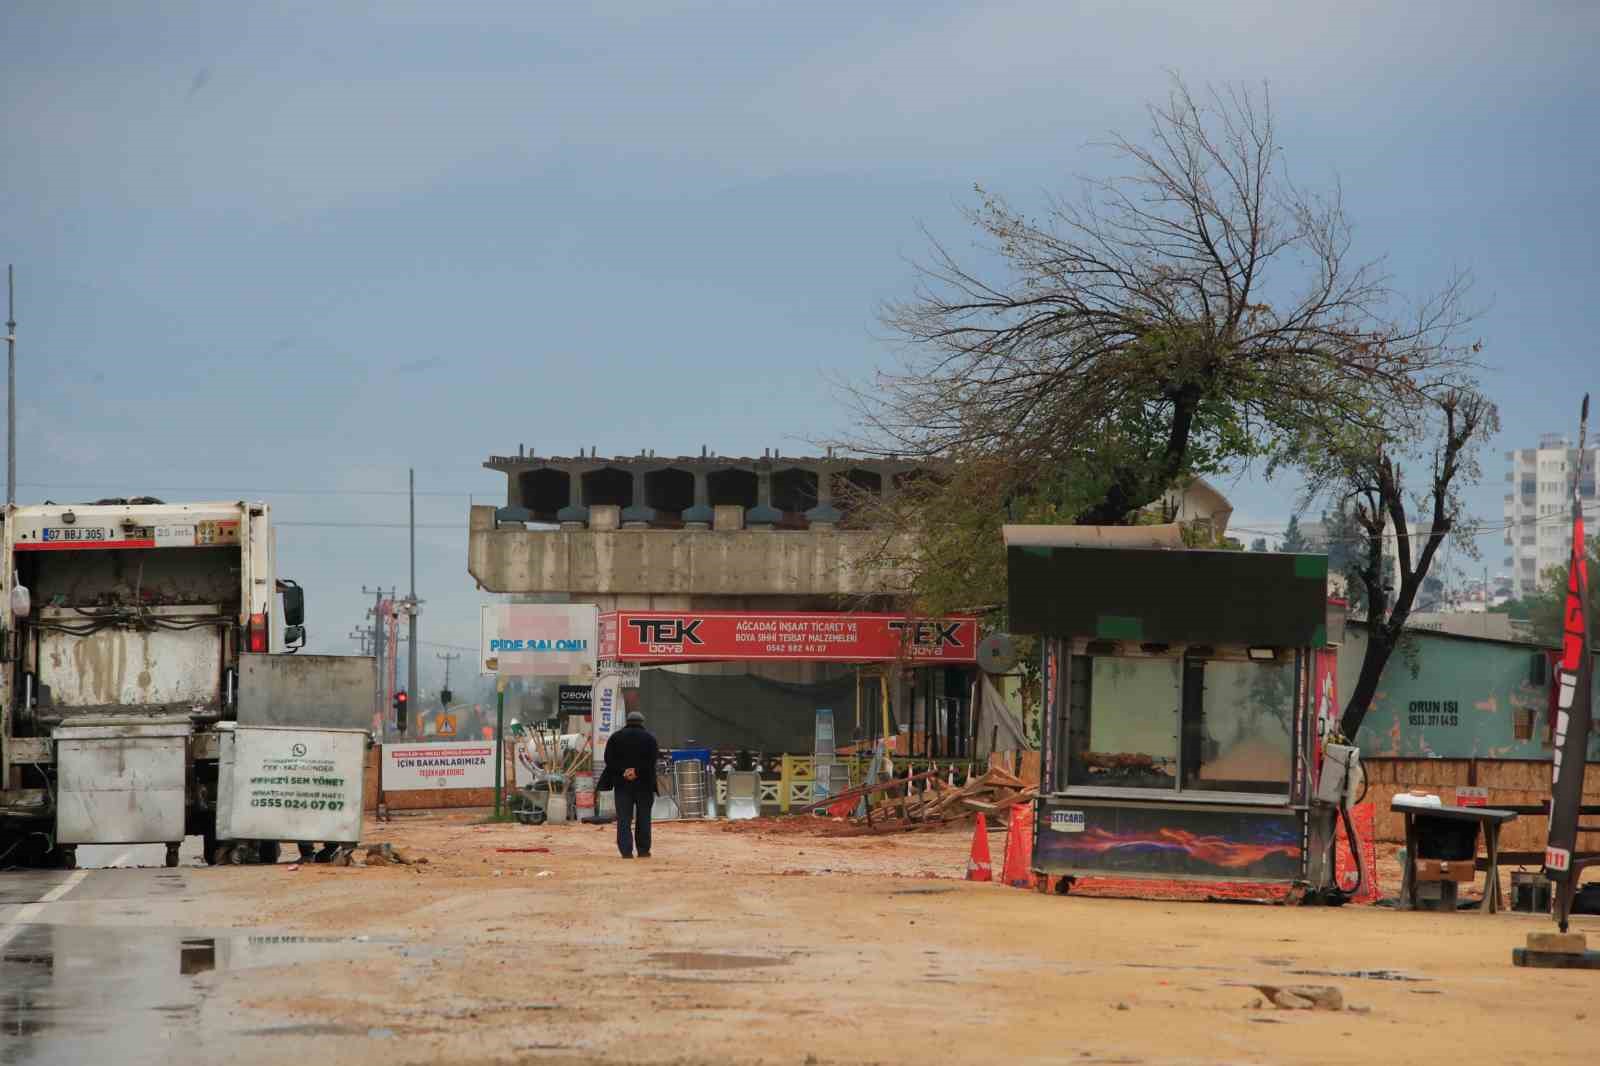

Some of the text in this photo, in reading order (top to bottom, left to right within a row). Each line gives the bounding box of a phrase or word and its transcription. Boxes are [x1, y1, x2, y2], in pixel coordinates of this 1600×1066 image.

[49, 528, 60, 540] 07
[85, 528, 102, 540] 305
[628, 619, 704, 645] TEK
[811, 621, 845, 632] TİCARET
[847, 622, 858, 632] VE
[736, 633, 755, 642] BOYA
[888, 621, 965, 648] TEK
[598, 688, 613, 732] kalde
[397, 757, 487, 769] İÇİN BAKANLARIMIZA
[291, 776, 310, 785] SEN
[311, 776, 345, 786] YÖNET
[250, 798, 345, 811] 0555 024 07 07
